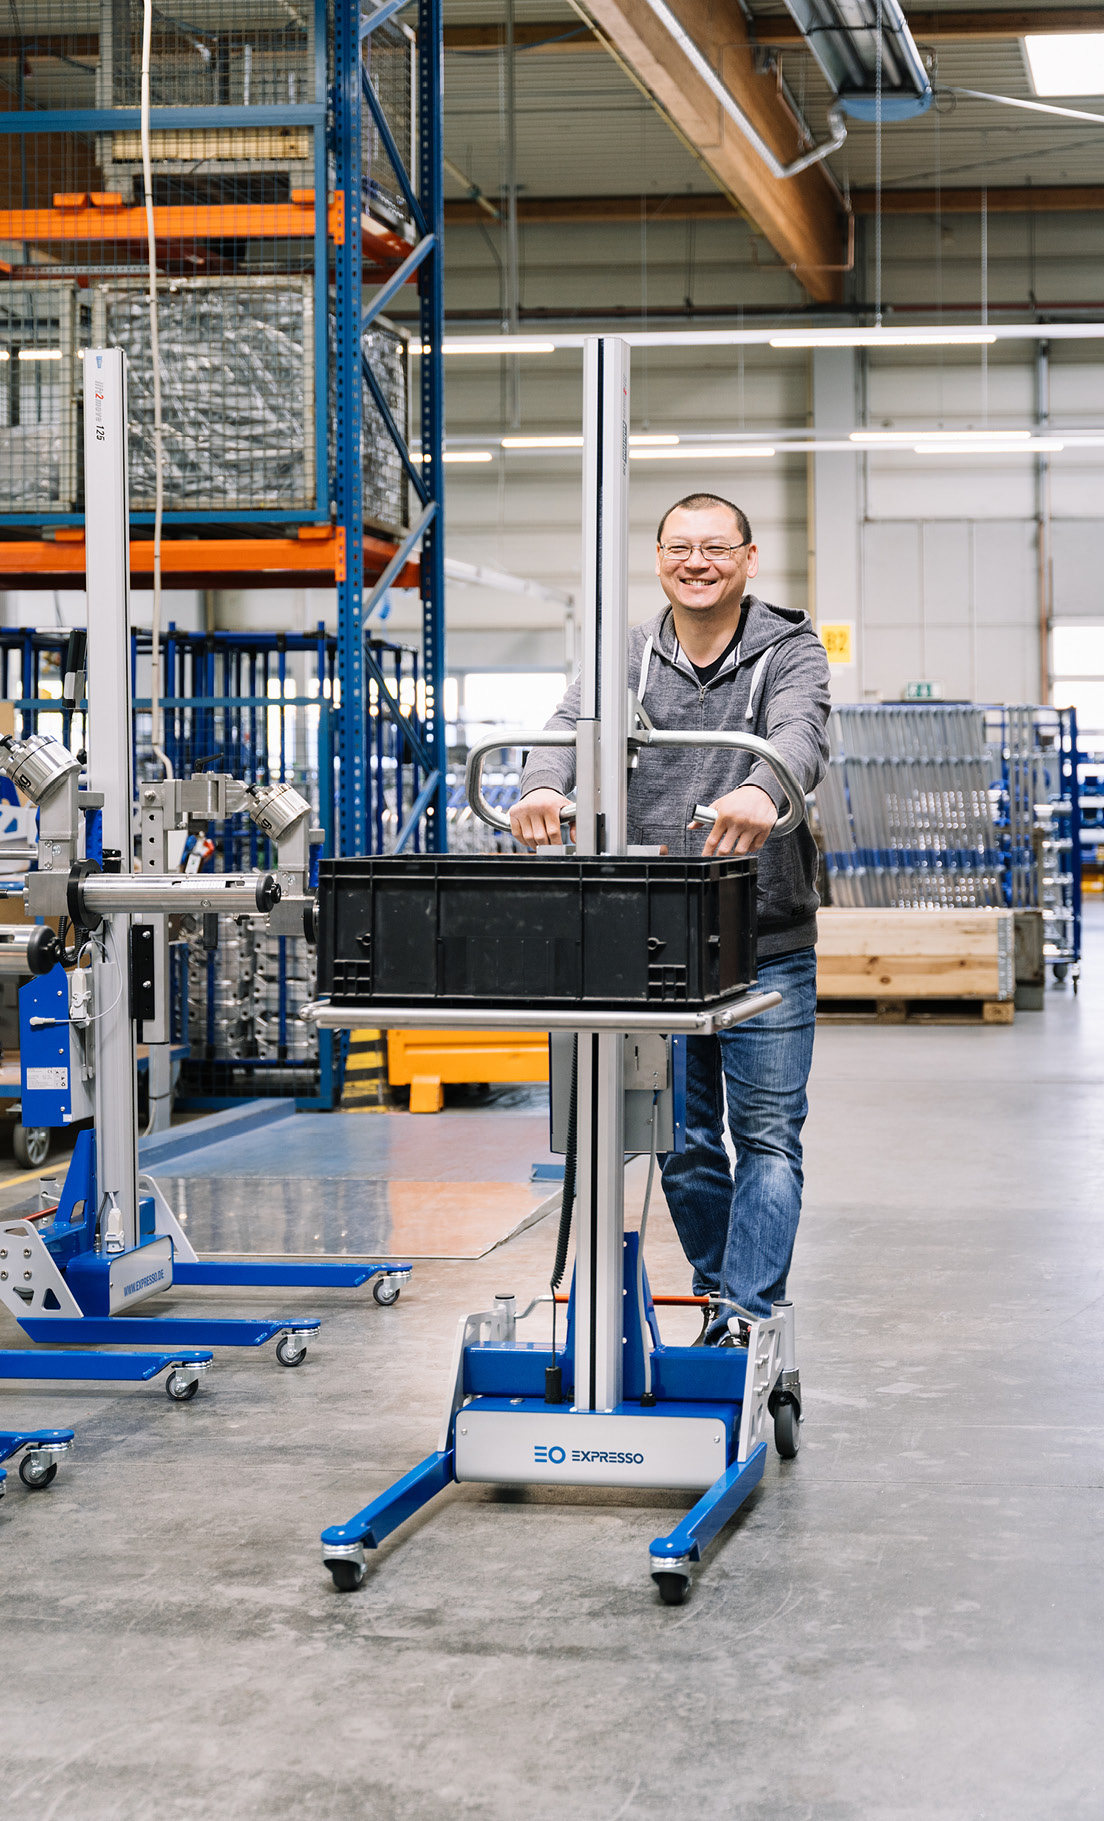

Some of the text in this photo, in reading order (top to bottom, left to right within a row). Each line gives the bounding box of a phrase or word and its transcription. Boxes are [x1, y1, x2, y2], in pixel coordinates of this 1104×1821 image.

[96, 424, 106, 442] 125
[826, 631, 848, 653] B2
[123, 1269, 165, 1297] WWW.EXPRESSO.DE
[571, 1450, 645, 1465] EXPRESSO
